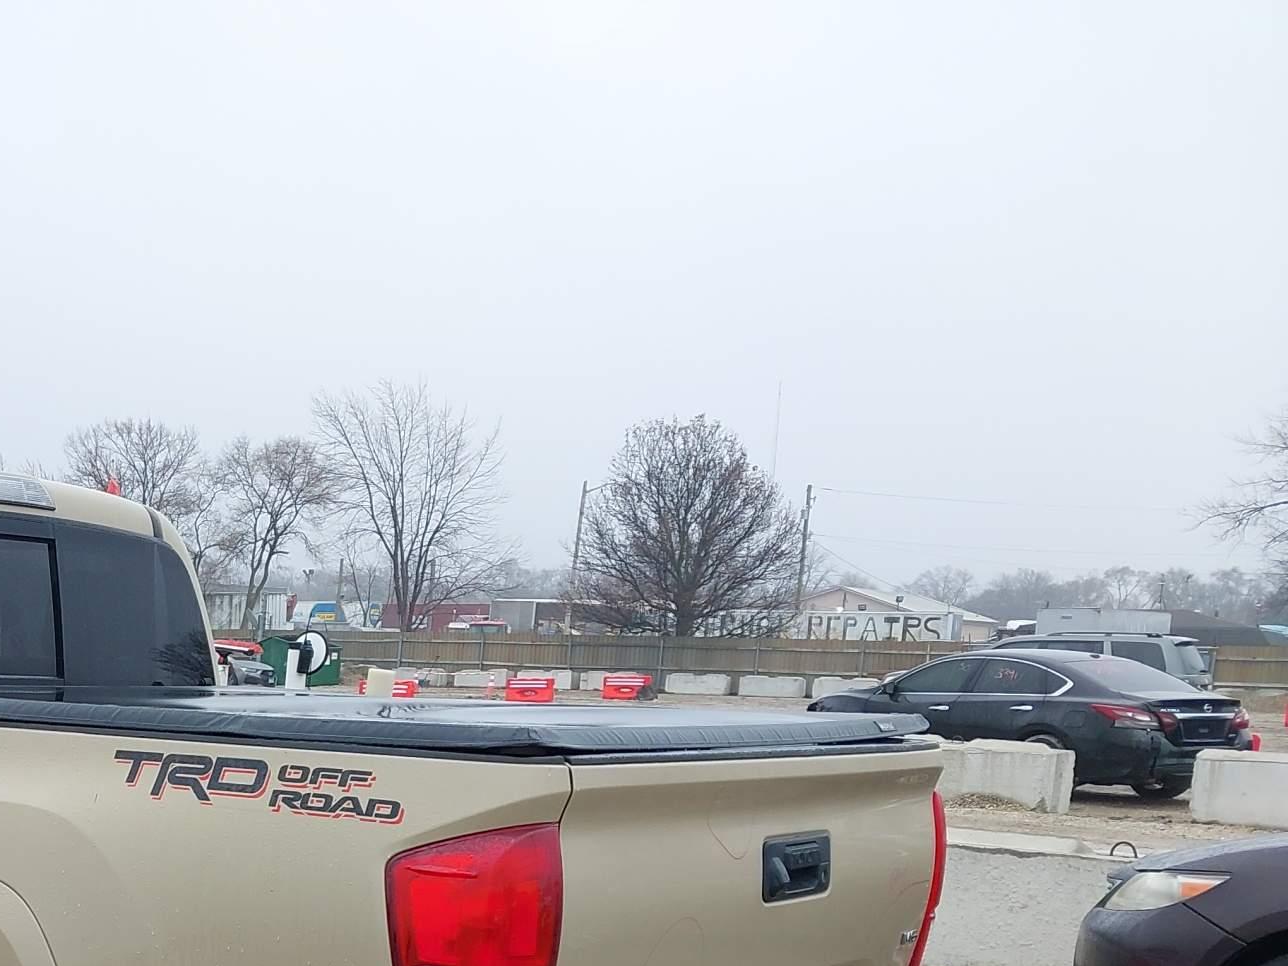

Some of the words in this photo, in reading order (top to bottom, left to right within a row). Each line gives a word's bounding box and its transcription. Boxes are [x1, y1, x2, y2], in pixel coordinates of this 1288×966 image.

[807, 615, 941, 642] REPAIRS
[113, 749, 272, 806] TRD
[276, 763, 377, 793] OFF
[267, 788, 406, 825] ROAD
